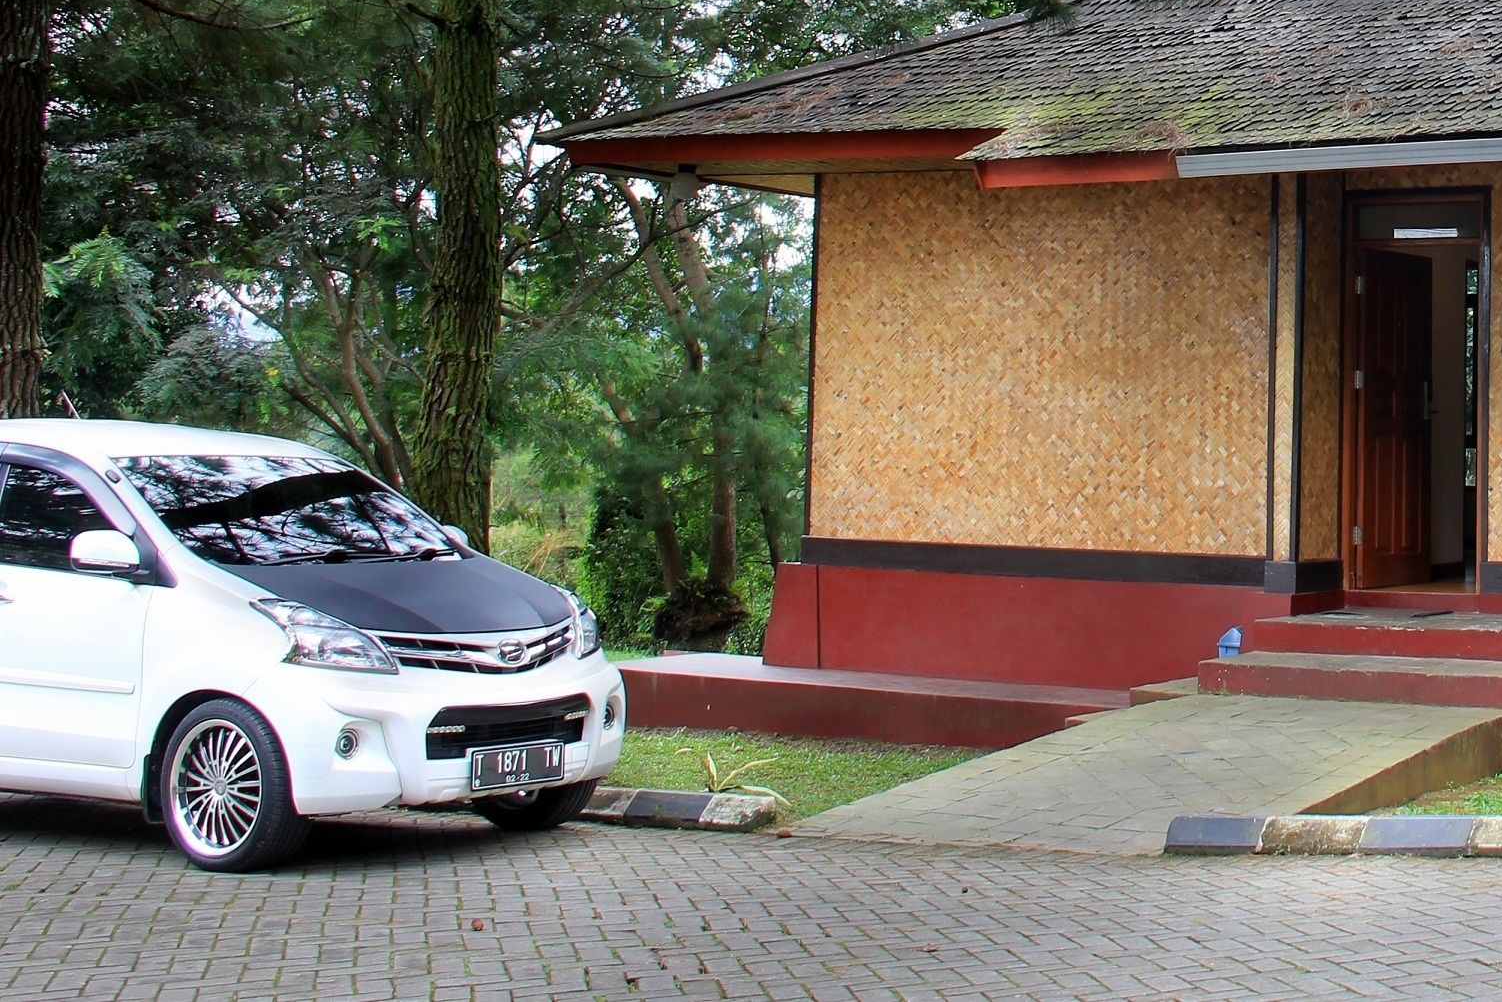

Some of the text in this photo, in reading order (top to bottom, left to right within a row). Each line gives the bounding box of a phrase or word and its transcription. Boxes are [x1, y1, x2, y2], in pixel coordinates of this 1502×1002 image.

[475, 745, 561, 777] T 1871 TW
